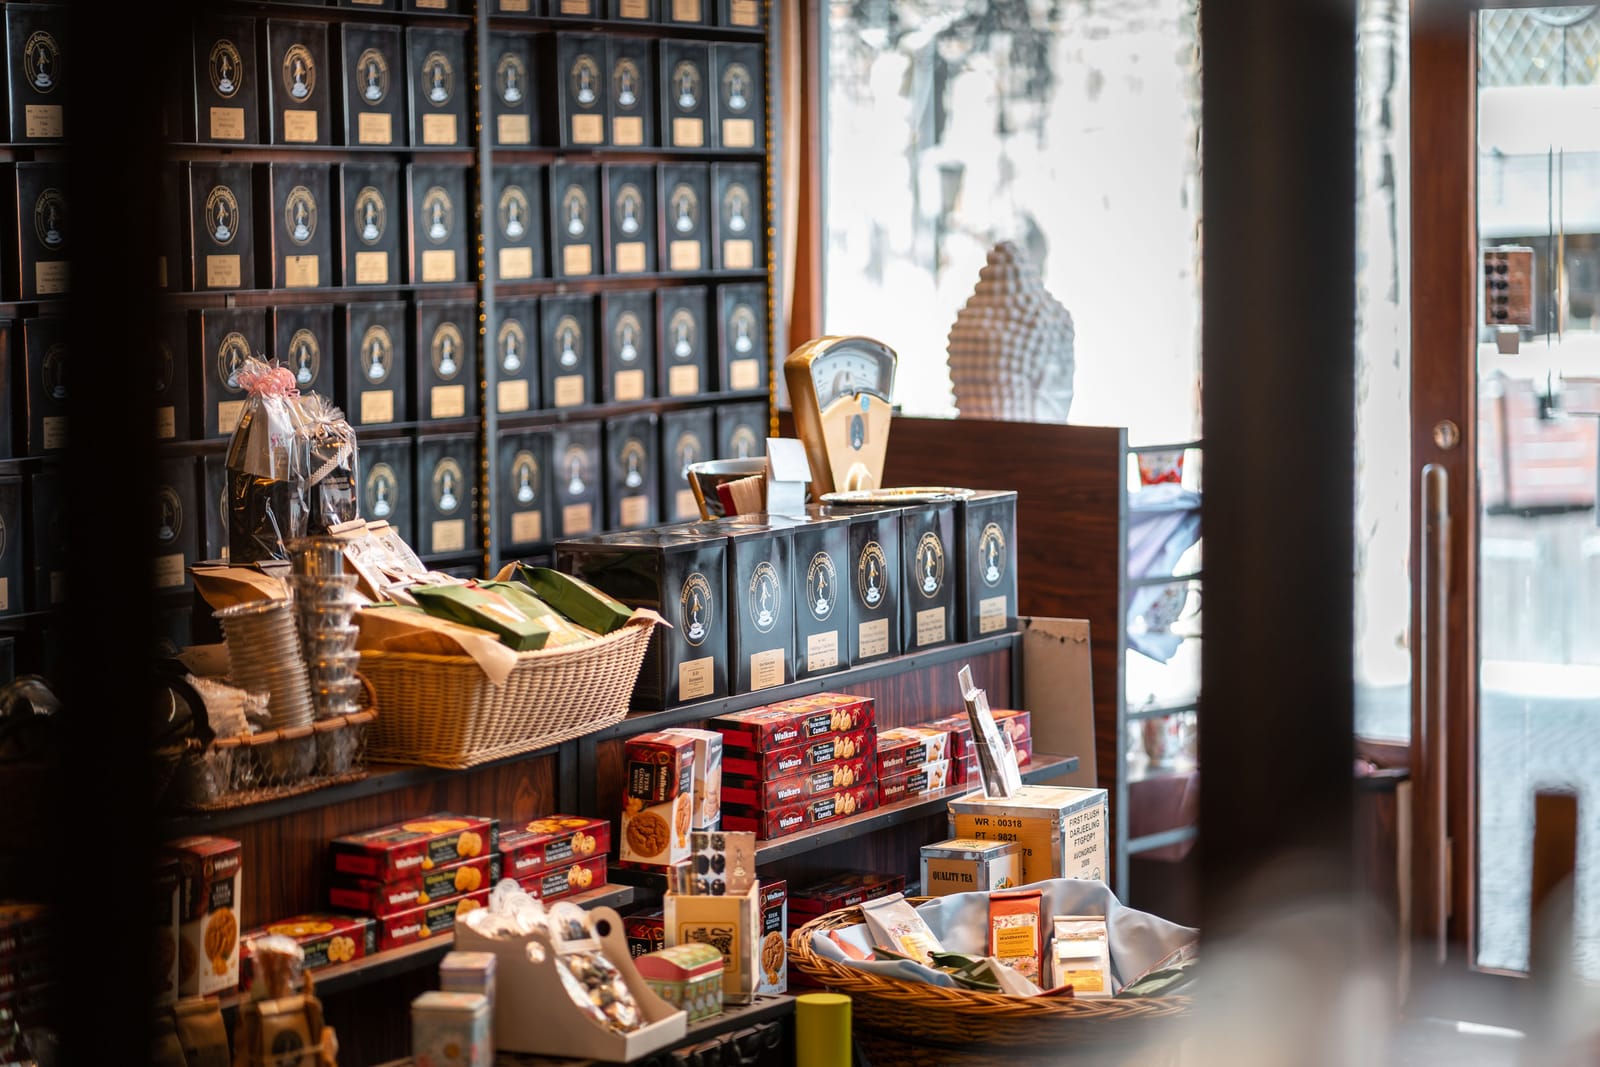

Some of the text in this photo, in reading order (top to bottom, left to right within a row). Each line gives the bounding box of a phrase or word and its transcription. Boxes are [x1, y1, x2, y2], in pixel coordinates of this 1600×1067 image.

[774, 730, 798, 741] Walkers
[779, 759, 802, 770] Walkers
[882, 758, 904, 768] Walkers
[660, 766, 668, 801] Walkers
[777, 788, 801, 799] Walkers
[884, 785, 905, 796] Walkers
[780, 816, 803, 827] Walkers
[975, 817, 990, 826] WR
[997, 819, 1022, 828] 00318
[1069, 808, 1100, 827] FIRST FLUSH
[1070, 819, 1100, 838] DARJEELING
[975, 831, 986, 839] PT
[997, 833, 1017, 841] 9821
[1074, 832, 1096, 847] FTGFOP1
[395, 855, 424, 869] Walkers
[515, 857, 541, 869] Walkers
[932, 871, 973, 883] QUALITY TEA
[389, 890, 420, 904] Walkers
[767, 891, 785, 901] Walkers
[391, 924, 421, 938] Walkers
